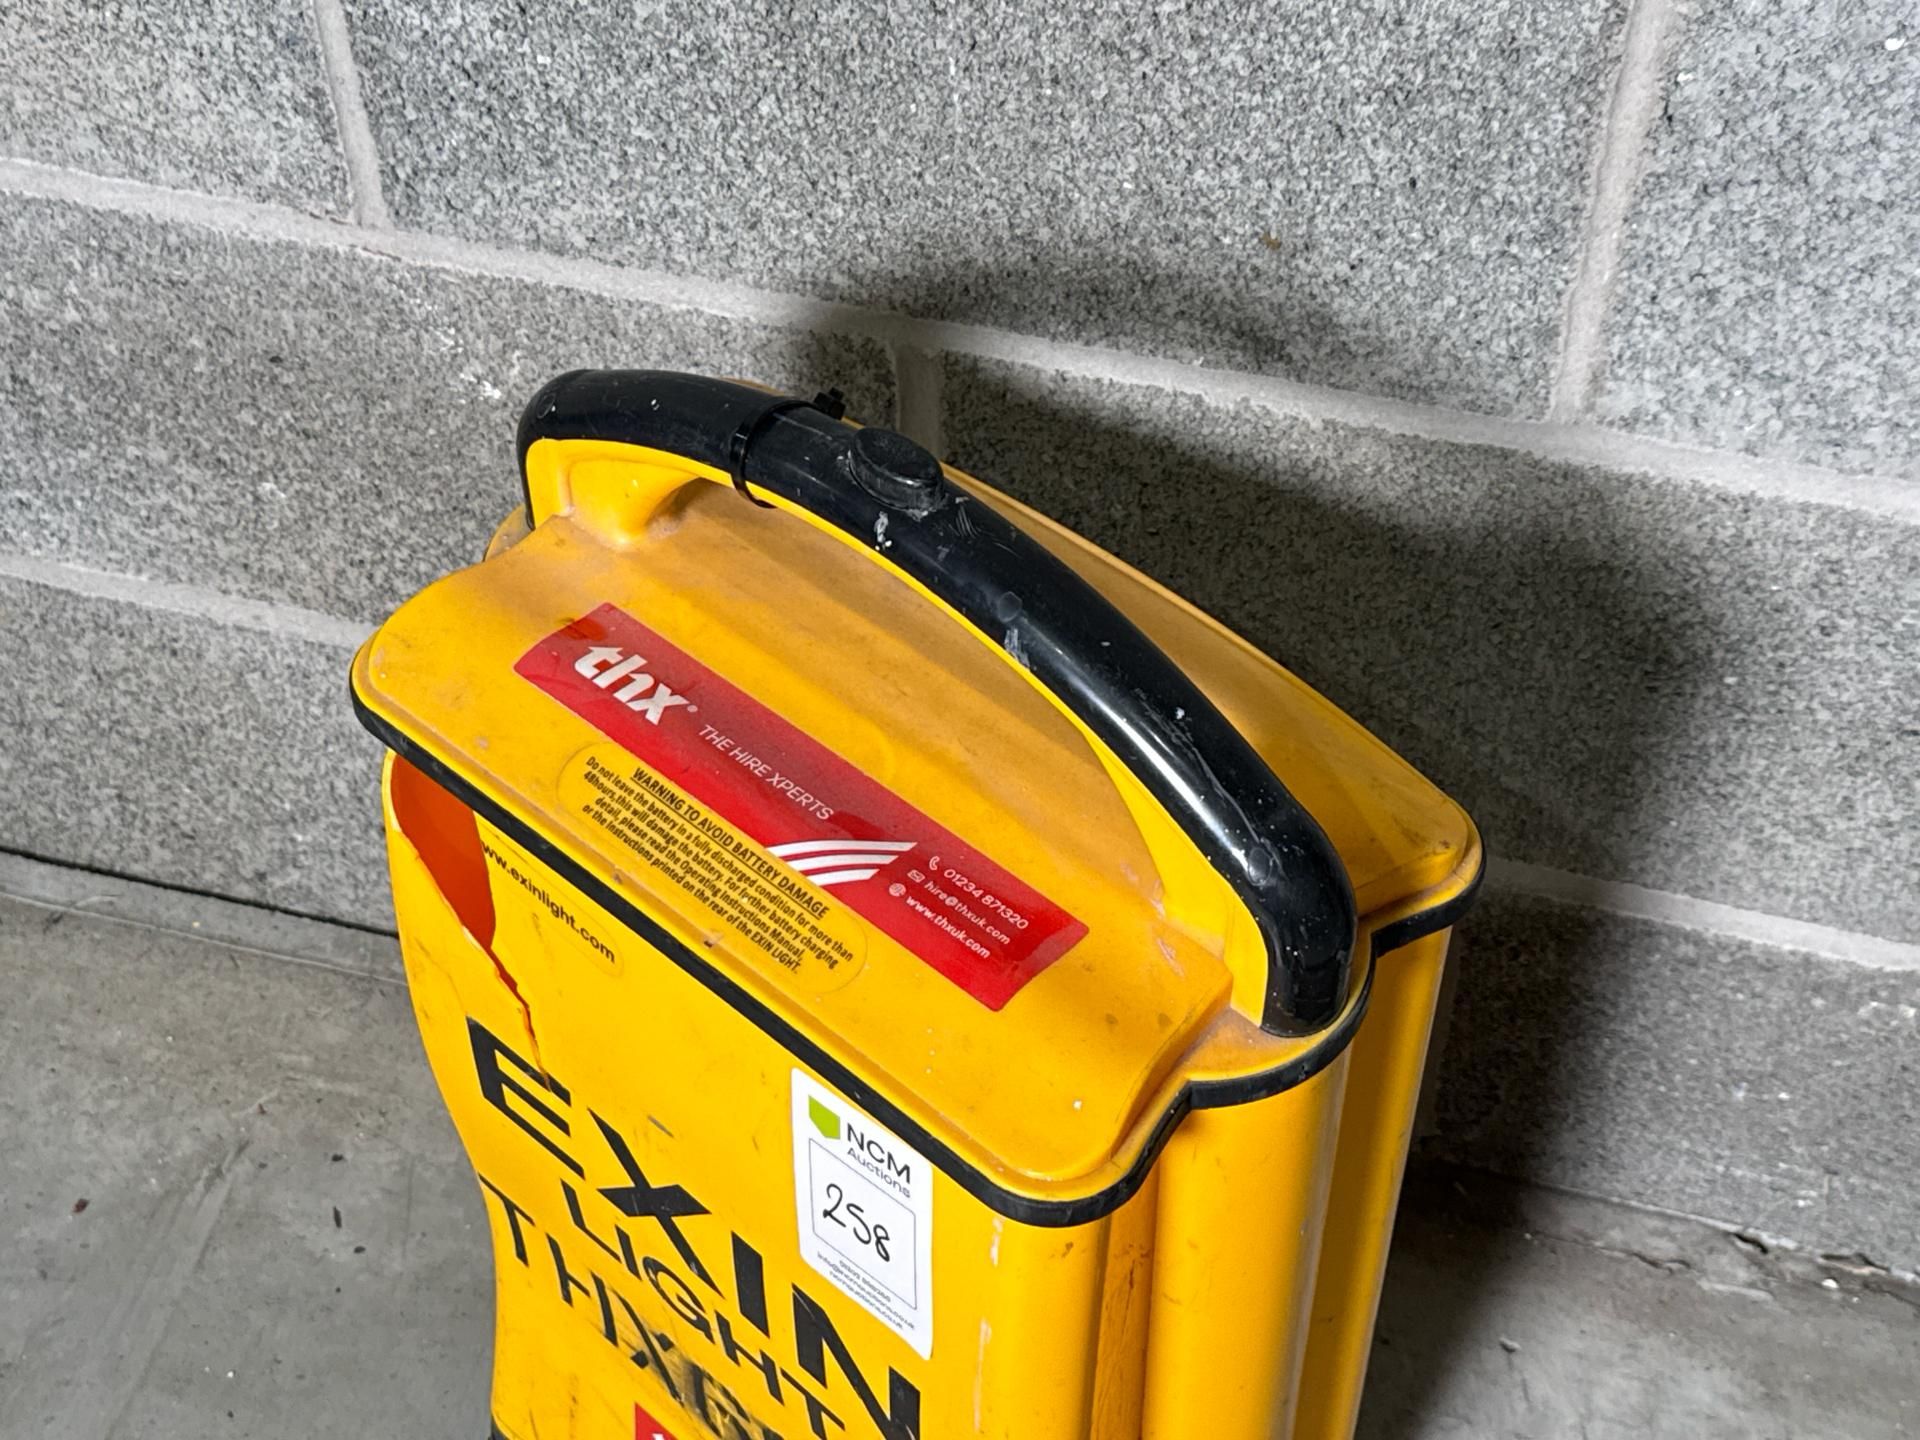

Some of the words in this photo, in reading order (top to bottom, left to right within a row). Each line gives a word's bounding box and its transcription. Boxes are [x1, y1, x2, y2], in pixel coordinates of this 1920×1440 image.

[575, 646, 690, 726] thx
[699, 724, 735, 751] THE
[729, 747, 772, 777] HIRE
[766, 772, 835, 820] XPERTS
[581, 804, 594, 814] or
[591, 809, 607, 826] the
[605, 820, 654, 861] Instructions
[649, 857, 686, 884] printed
[681, 880, 695, 892] on
[693, 887, 710, 903] the
[707, 900, 728, 917] rear
[725, 913, 740, 924] of
[735, 919, 752, 936] the
[749, 930, 774, 952] EXIN
[586, 756, 600, 770] Do
[597, 766, 614, 781] not
[611, 774, 635, 796] leave
[632, 791, 649, 807] the
[646, 801, 678, 830] battery
[675, 823, 687, 836] in
[684, 832, 693, 841] a
[691, 834, 712, 856] fully
[710, 850, 758, 889] discharged
[754, 884, 796, 918] condition
[794, 911, 810, 927] for
[807, 924, 832, 946] more
[830, 940, 853, 961] than
[594, 796, 621, 821] detail,
[617, 816, 648, 840] please
[645, 835, 669, 854] read
[664, 849, 681, 865] the
[679, 859, 721, 897] Operating
[719, 890, 770, 933] Instructions
[768, 927, 805, 961] Manual,
[630, 807, 650, 823] will
[645, 818, 679, 846] damage
[676, 841, 693, 857] the
[691, 851, 723, 881] battery.
[723, 876, 740, 892] For
[767, 909, 801, 940] battery
[799, 936, 838, 969] charging
[632, 767, 685, 810] WARNING
[682, 804, 700, 821] TO
[696, 817, 734, 847] AVOID
[731, 841, 781, 880] BATTERY
[777, 875, 829, 918] DAMAGE
[481, 841, 616, 964] ww.exinlight.com
[906, 895, 991, 959] www.thxuk.com
[924, 880, 1011, 945] hire@thxuk.com
[943, 868, 985, 898] 01234
[981, 894, 1029, 930] 871320
[847, 1122, 911, 1185] NCM
[847, 1147, 911, 1198] Auctions
[466, 1016, 920, 1440] EXIN
[823, 1182, 891, 1262] 258
[561, 1178, 846, 1440] LIGHT
